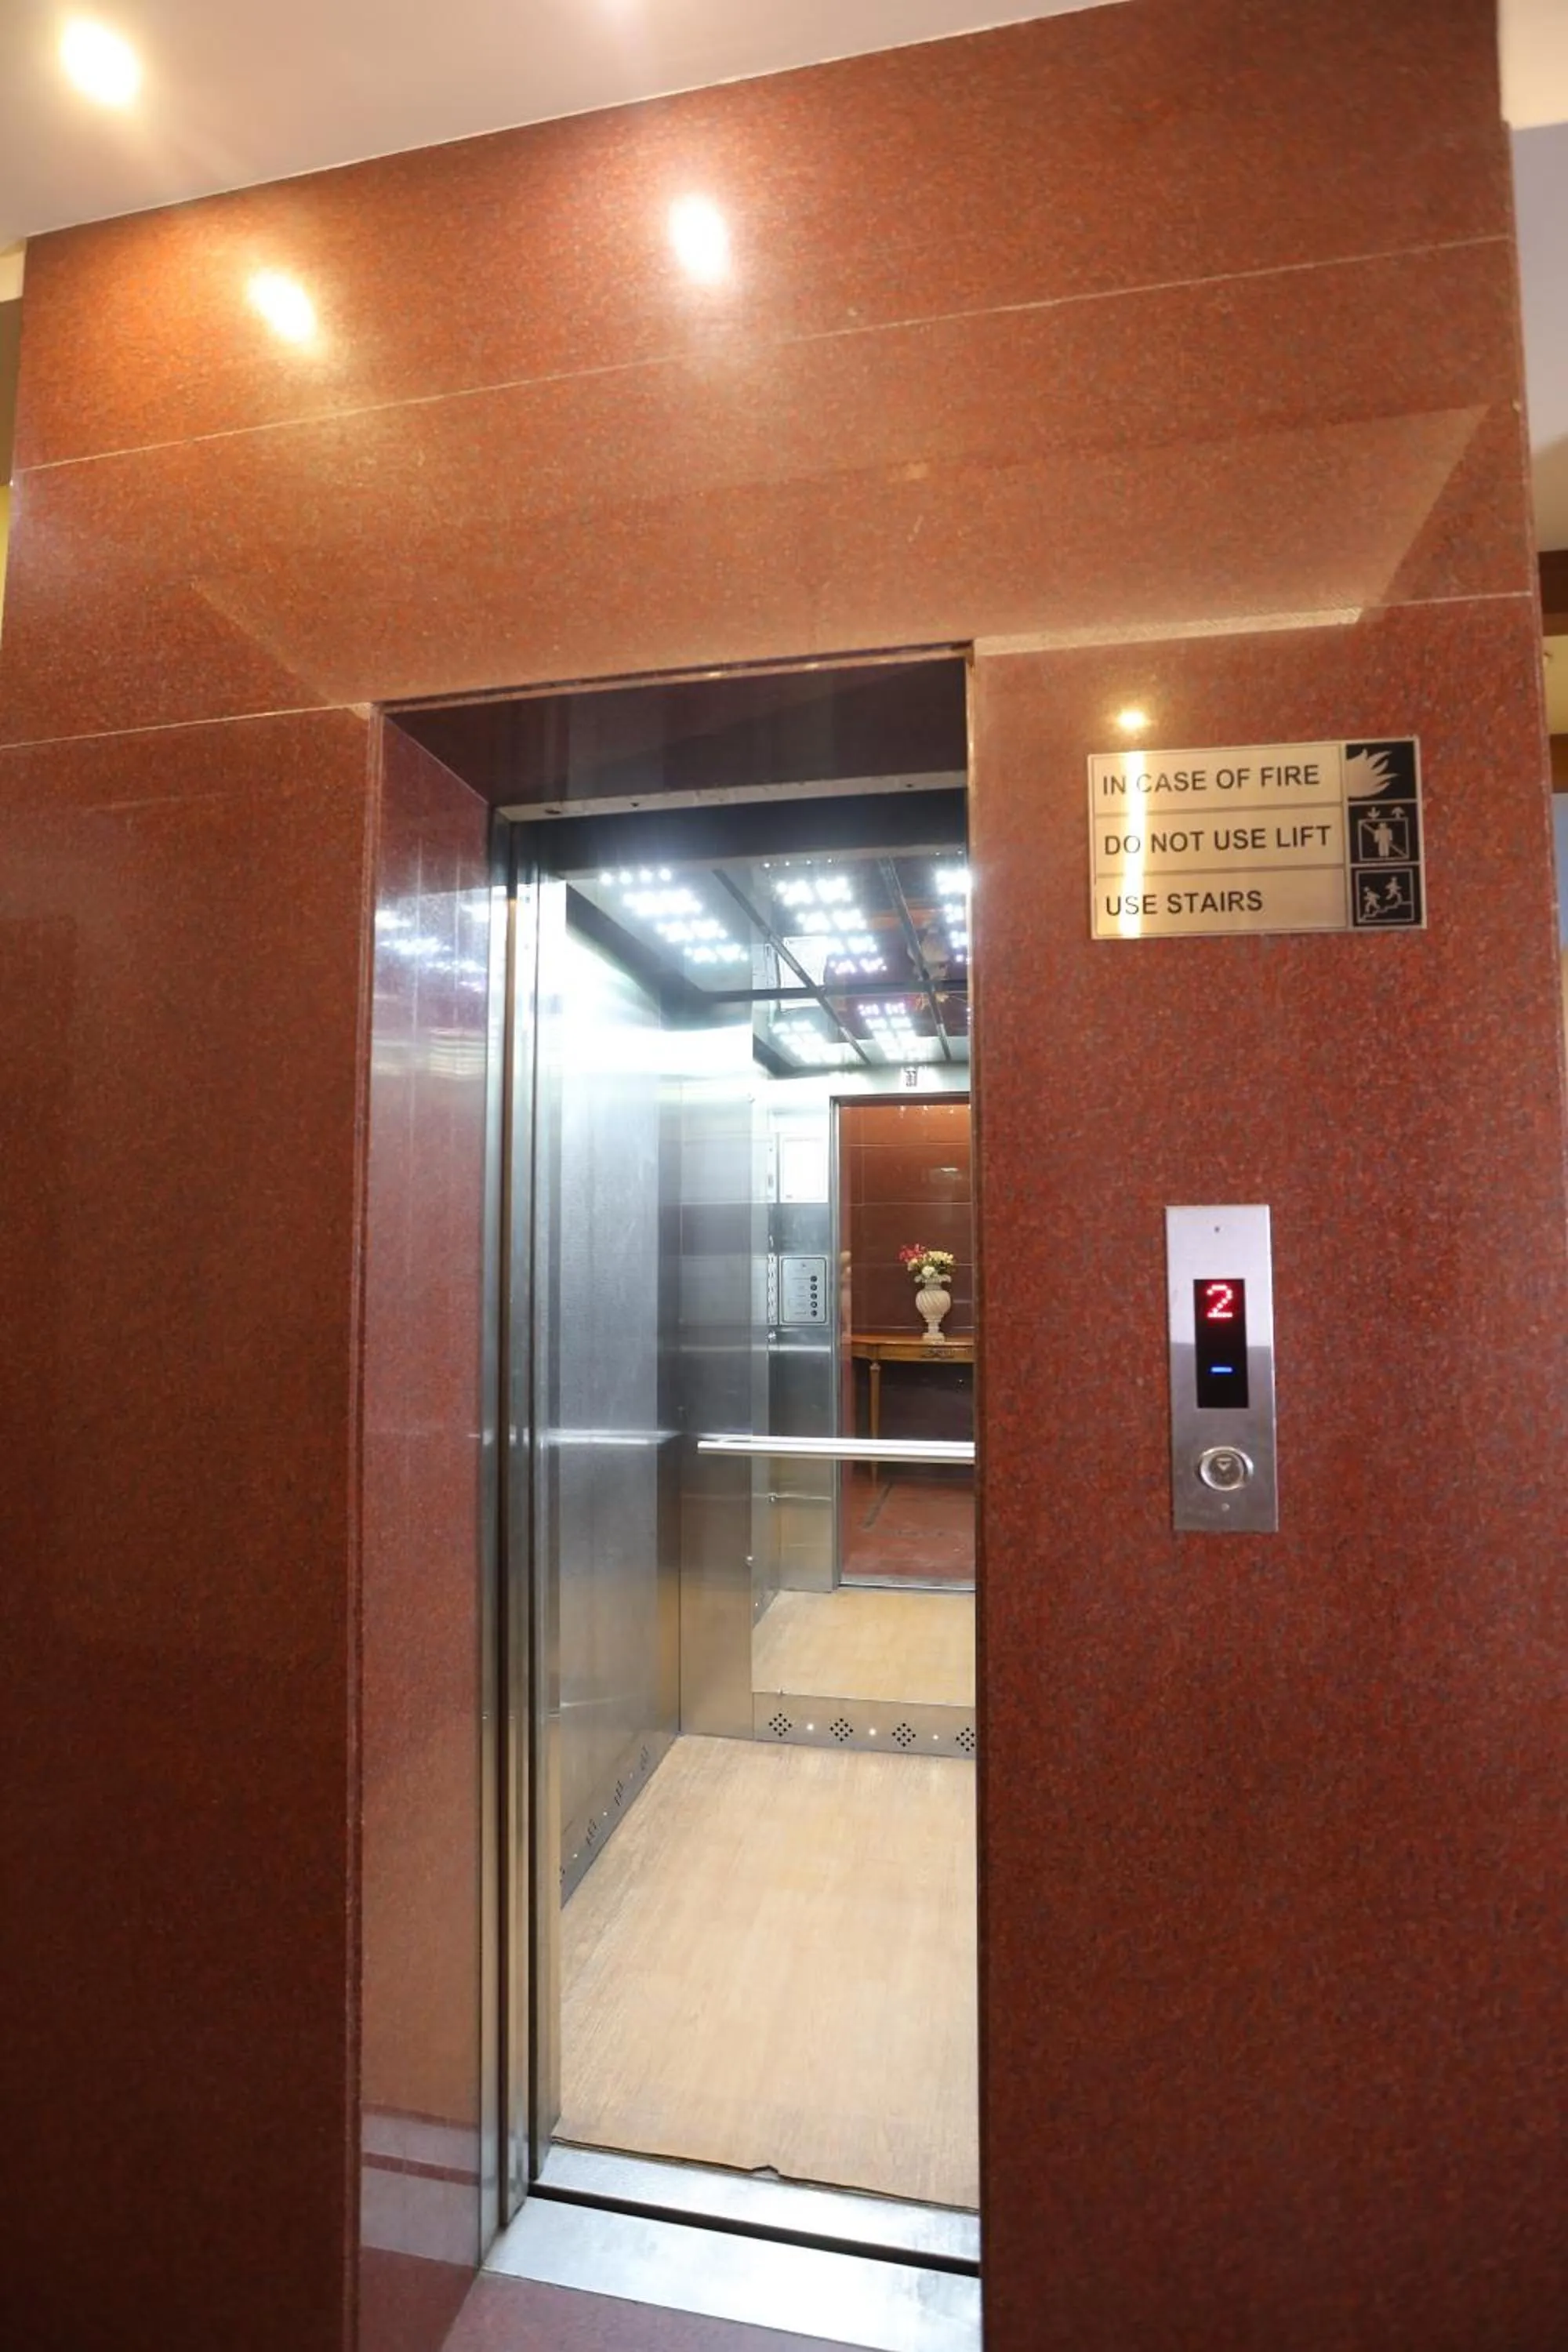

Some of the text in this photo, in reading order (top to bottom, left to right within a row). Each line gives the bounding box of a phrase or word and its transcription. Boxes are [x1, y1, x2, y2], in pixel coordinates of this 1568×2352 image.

[1102, 764, 1320, 796] IN CASE OF FIRE
[1105, 825, 1332, 855] DO NOT USE LIFT
[1105, 890, 1263, 916] USE STAIRS
[1207, 1284, 1233, 1318] 2
